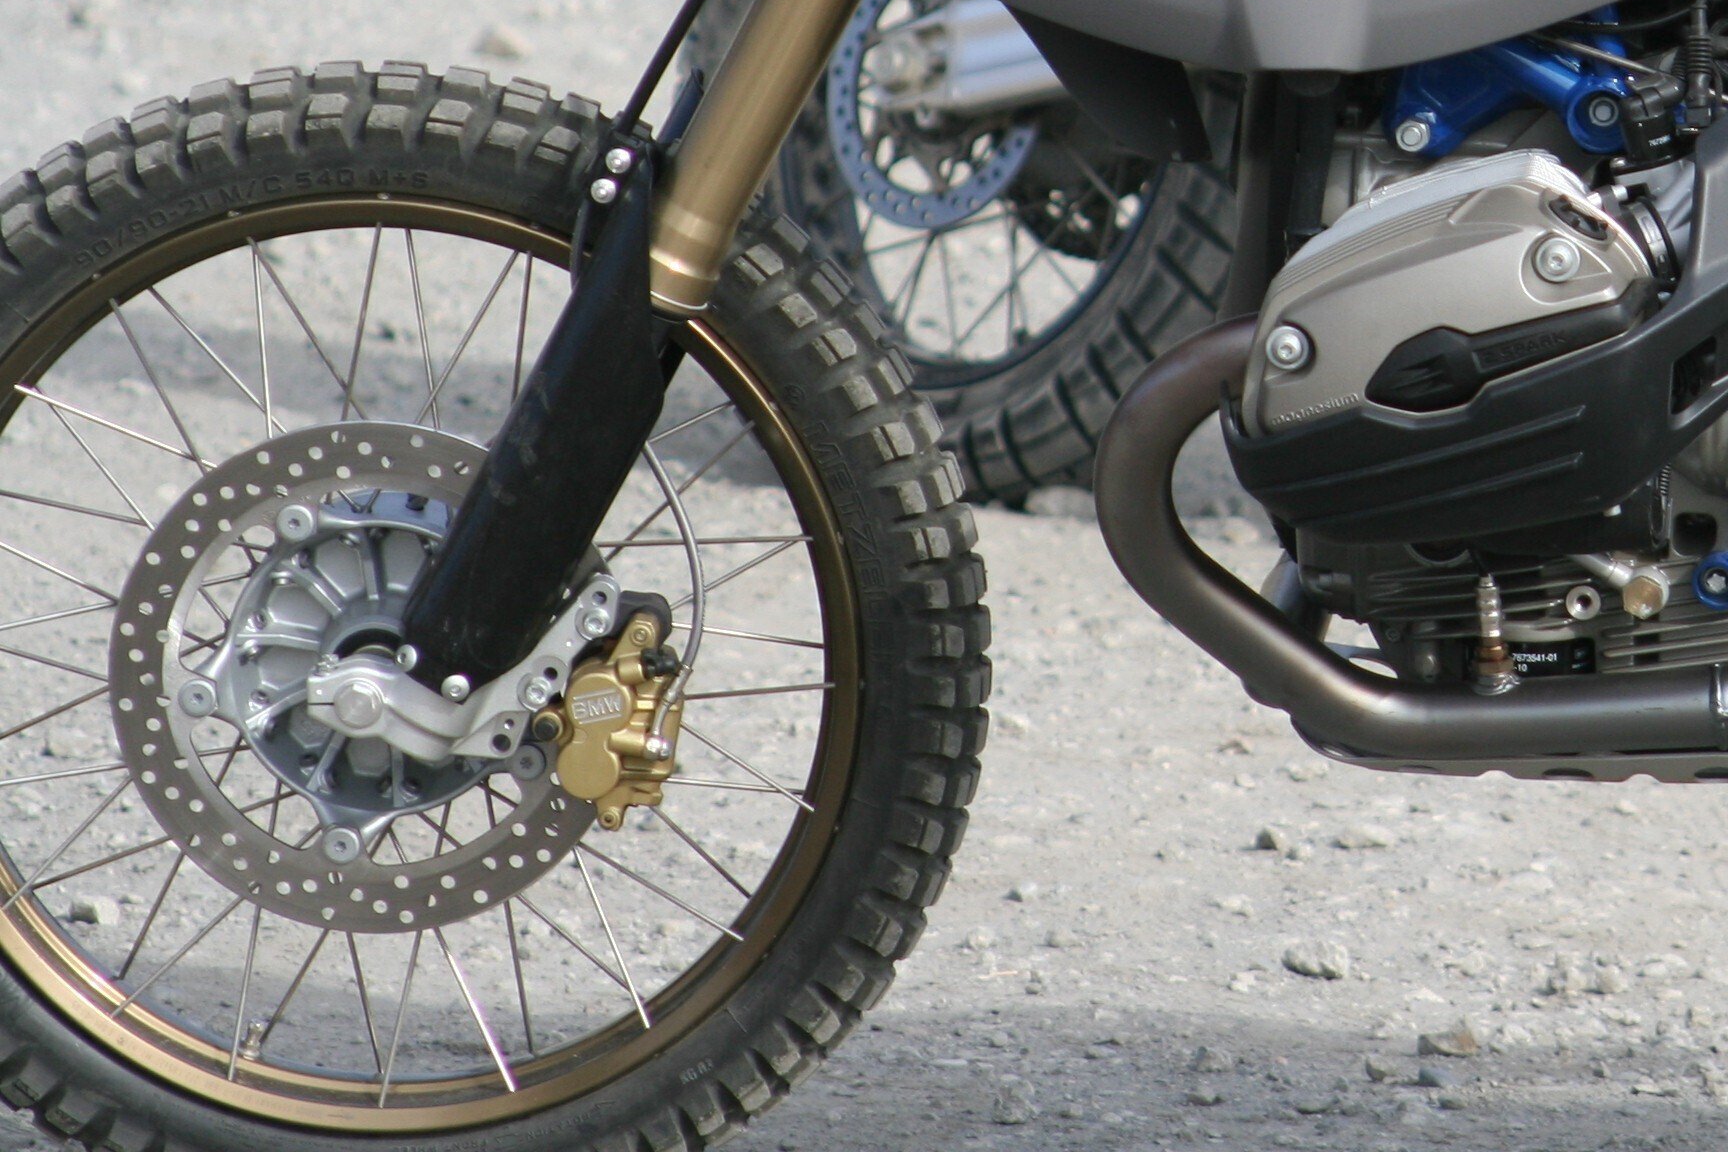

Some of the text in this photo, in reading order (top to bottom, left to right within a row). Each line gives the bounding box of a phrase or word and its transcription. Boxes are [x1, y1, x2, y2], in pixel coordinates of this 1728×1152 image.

[218, 175, 282, 206] M/C
[294, 167, 355, 191] 54Q
[368, 168, 430, 190] M+S
[571, 694, 622, 721] BMW
